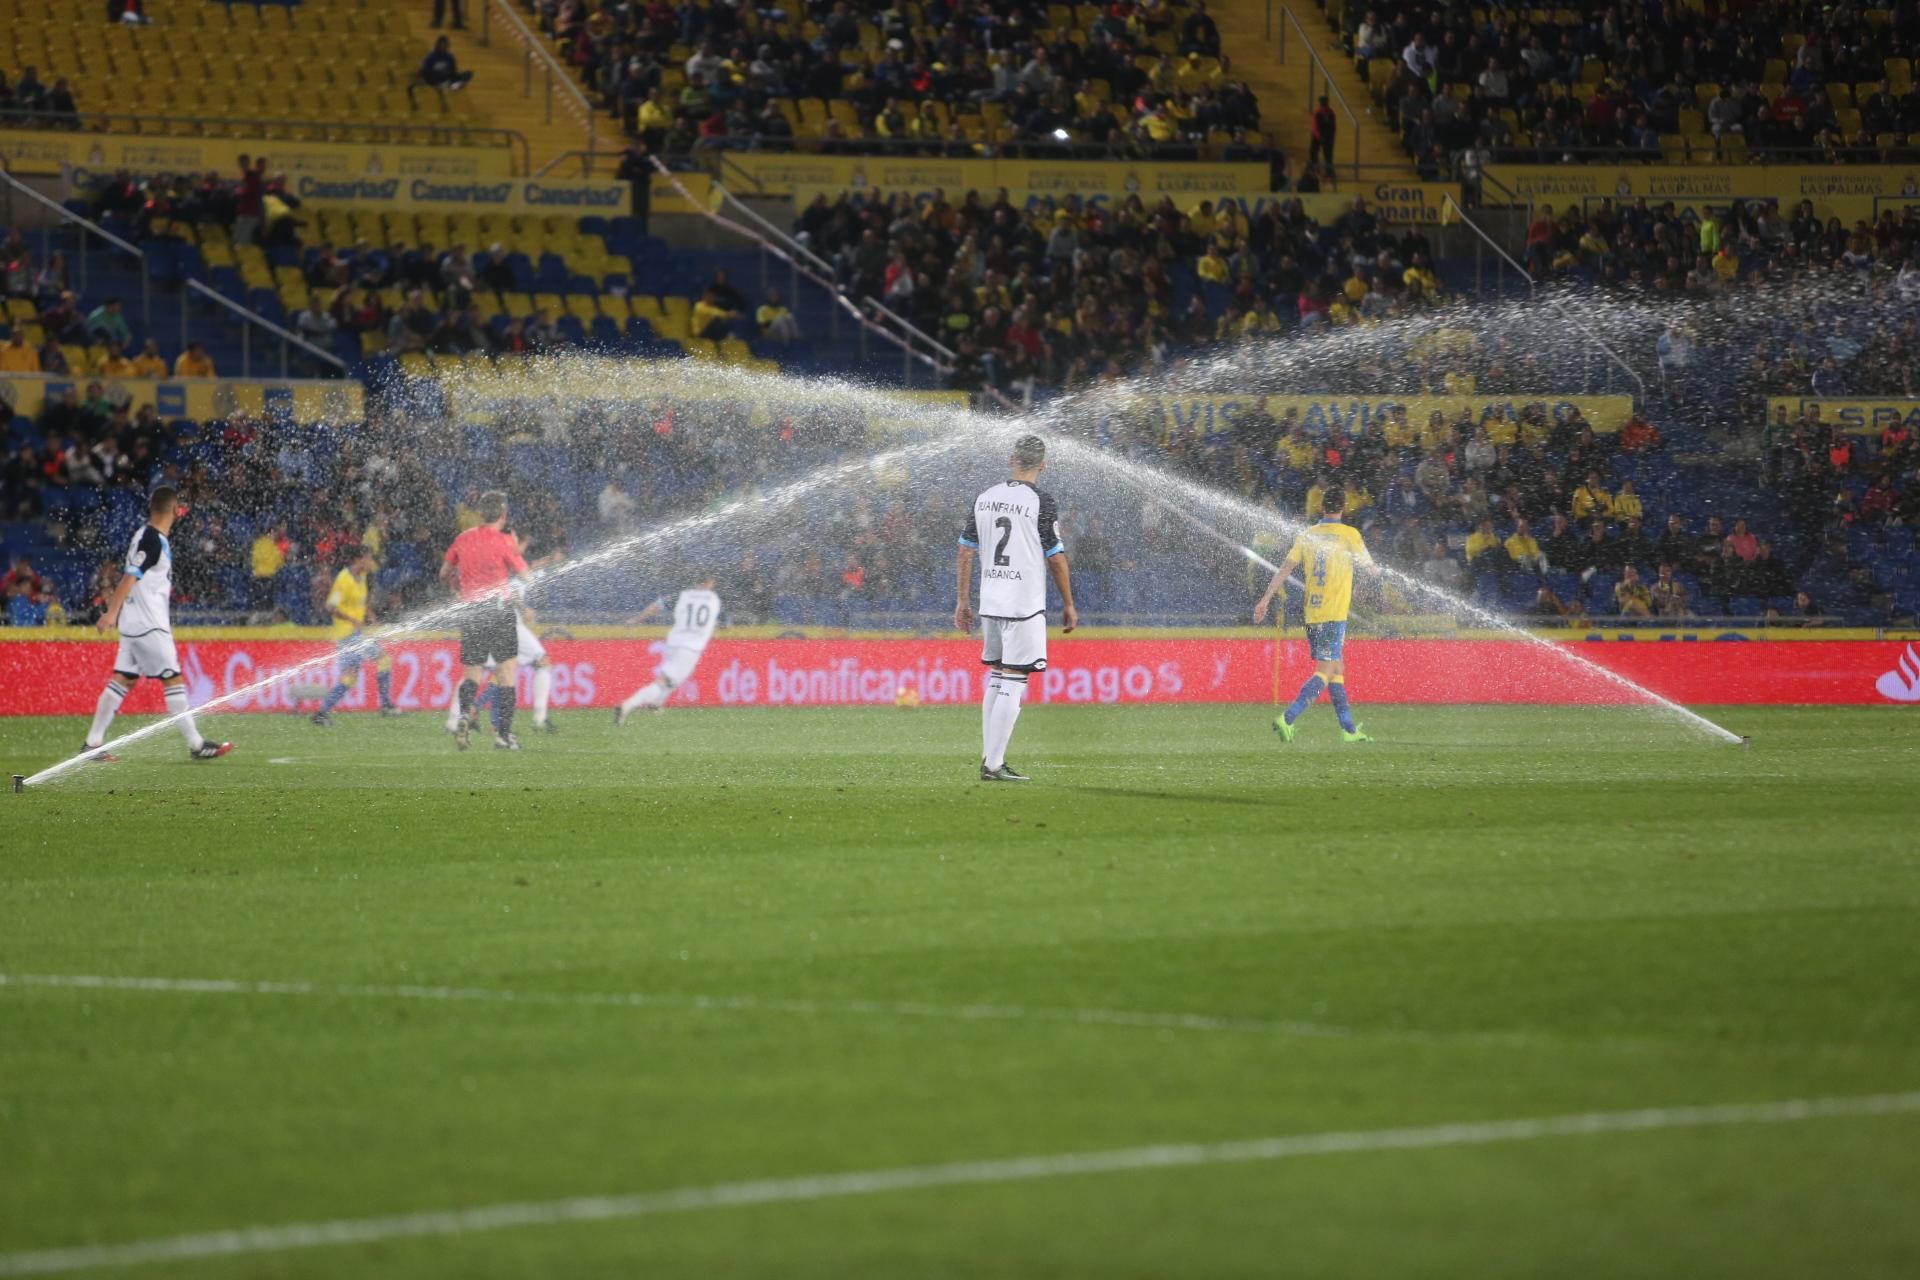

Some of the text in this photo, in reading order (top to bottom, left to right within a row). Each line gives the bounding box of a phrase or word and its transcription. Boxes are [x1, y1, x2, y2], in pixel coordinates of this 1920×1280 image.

[1375, 183, 1425, 201] Gran
[1374, 204, 1438, 221] anaria
[993, 516, 1012, 566] 2
[685, 603, 710, 629] 10
[718, 657, 758, 703] de
[768, 657, 970, 703] bonificación
[1041, 658, 1184, 705] pagos
